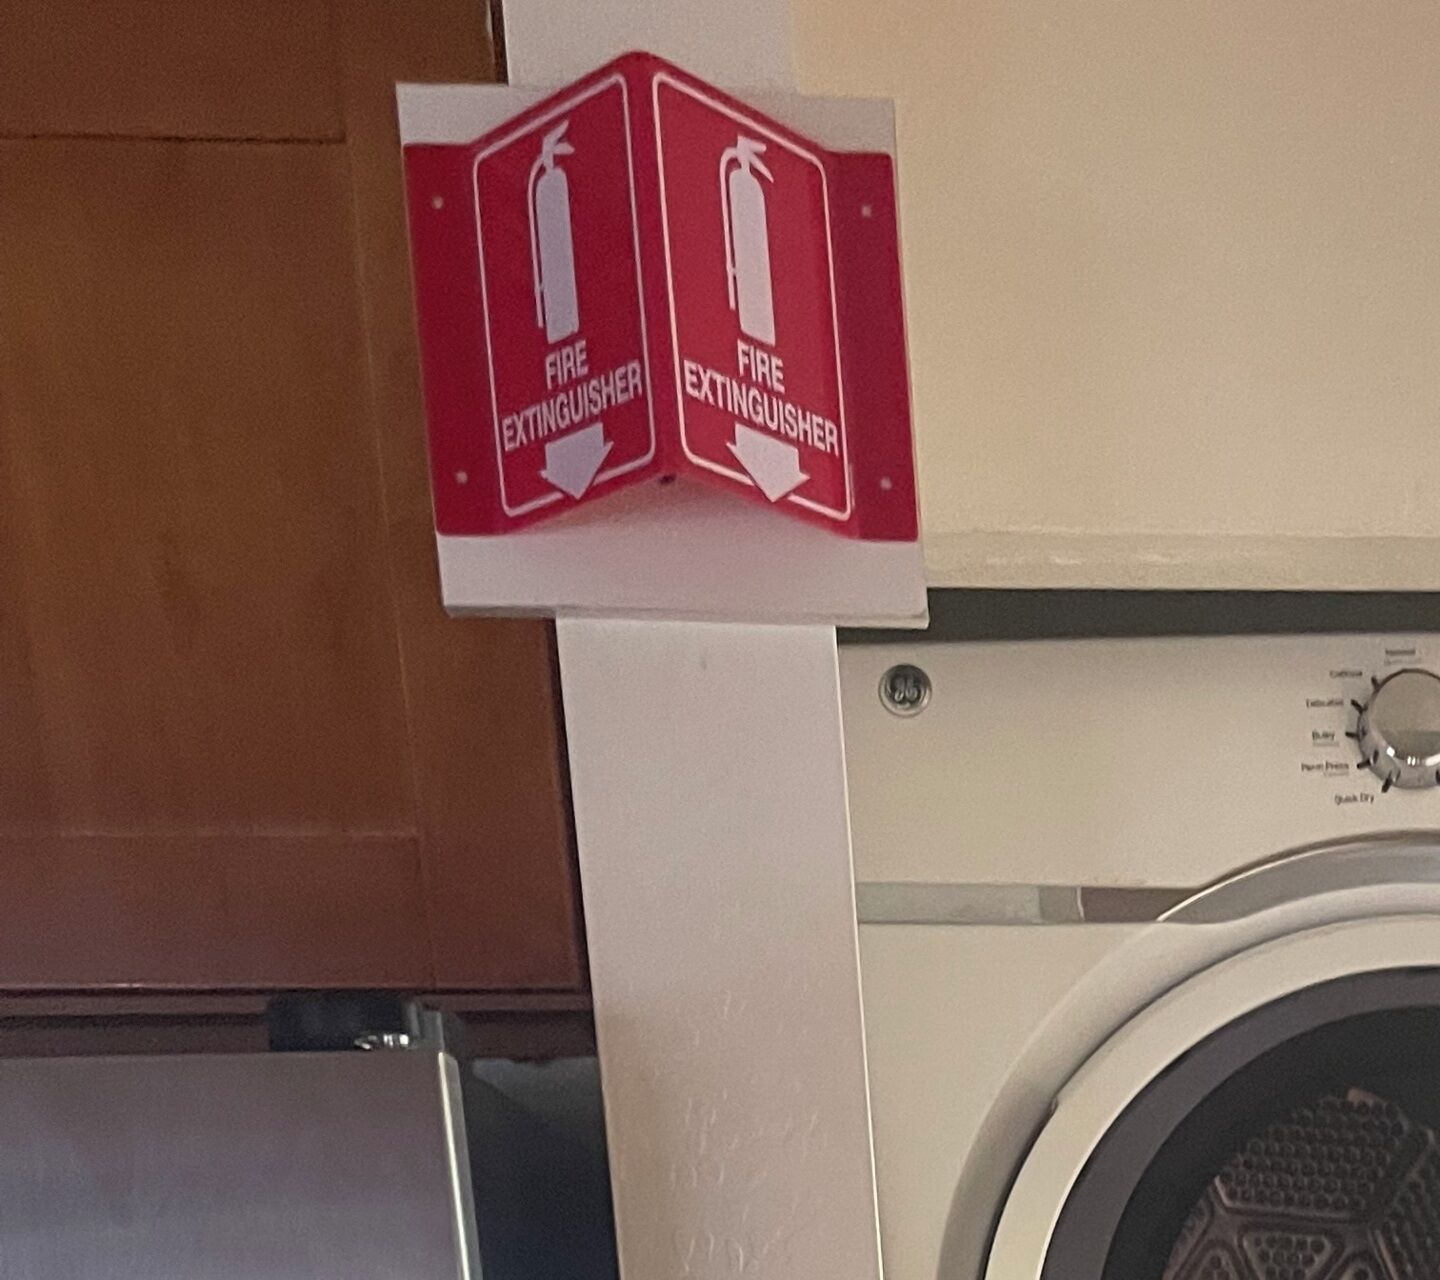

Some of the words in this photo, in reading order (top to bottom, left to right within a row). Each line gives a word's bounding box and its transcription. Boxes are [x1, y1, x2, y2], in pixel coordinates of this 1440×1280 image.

[544, 339, 589, 391] FIRE
[736, 338, 786, 394] FIRE
[501, 359, 643, 452] EXTINGUISHER
[683, 358, 840, 457] EXTINGUISHER
